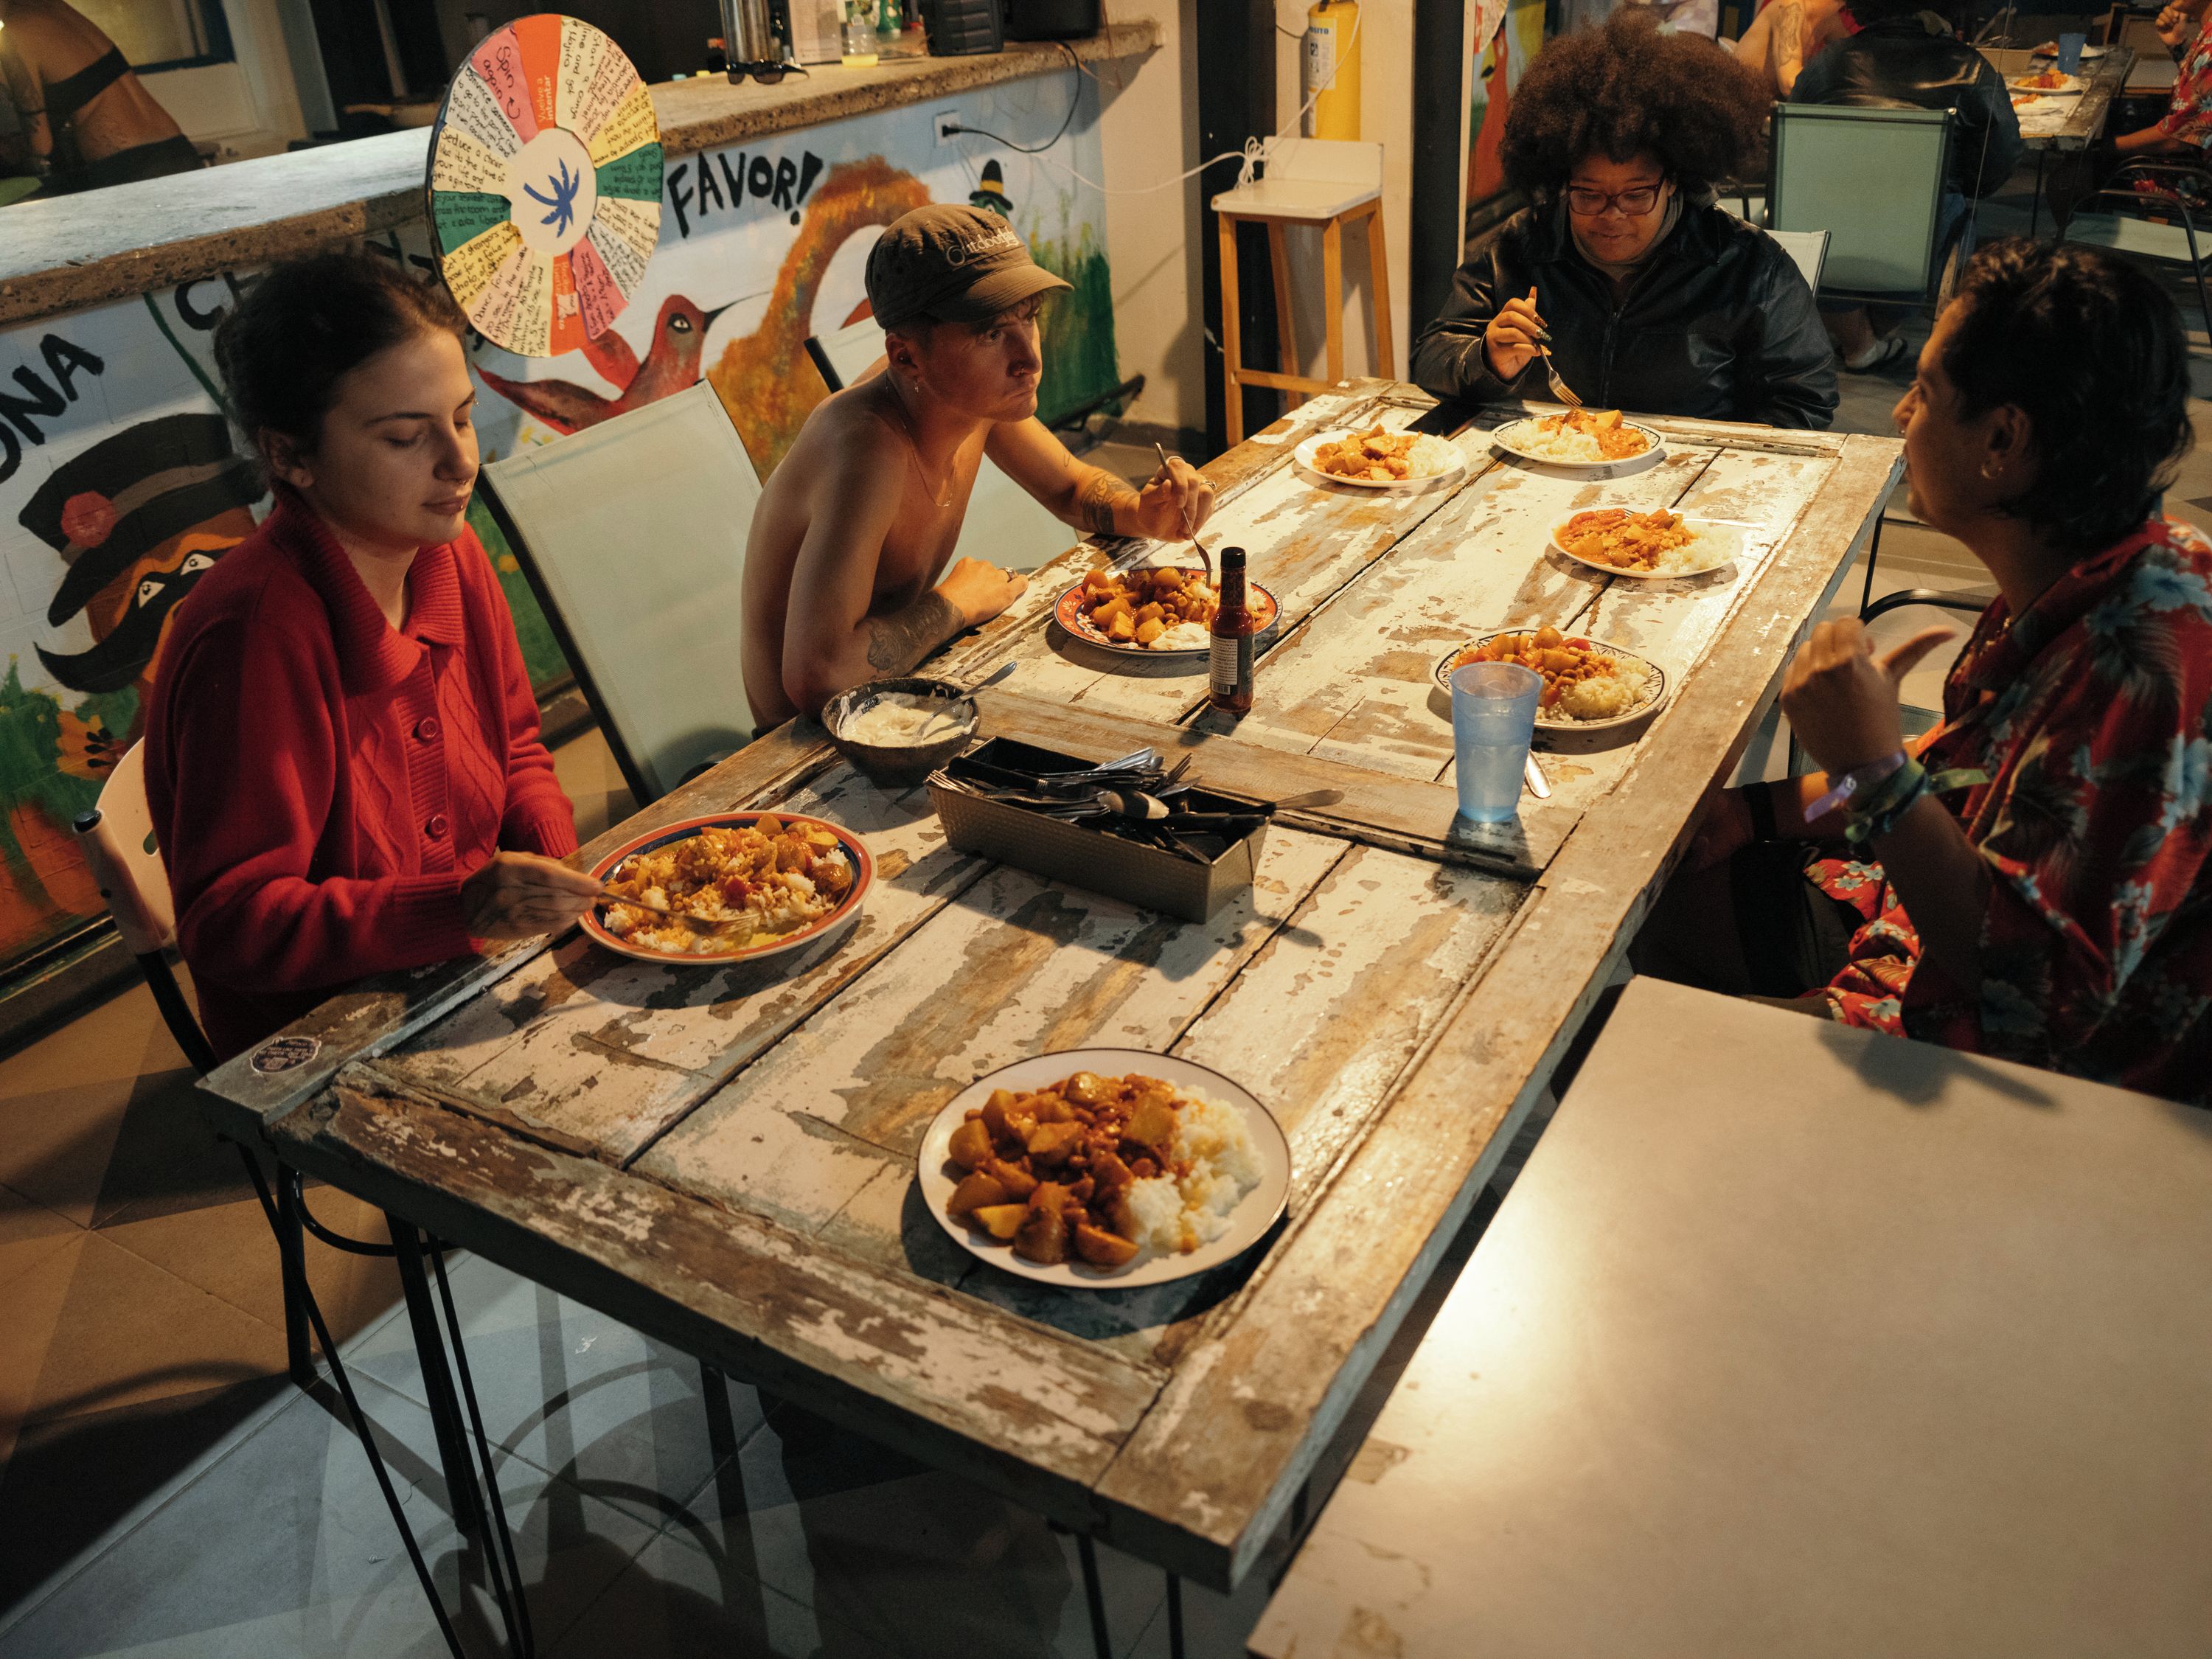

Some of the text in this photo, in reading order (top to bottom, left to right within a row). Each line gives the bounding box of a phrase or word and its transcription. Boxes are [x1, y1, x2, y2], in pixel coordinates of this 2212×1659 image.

[496, 46, 514, 88] Spin
[566, 28, 591, 94] line and get
[589, 32, 601, 67] Start
[484, 60, 502, 100] again
[544, 75, 553, 120] intentar
[570, 90, 584, 119] conga
[441, 128, 472, 153] Seduce
[476, 149, 481, 157] a
[667, 150, 823, 239] FAVOR!
[473, 292, 493, 324] Dance
[490, 271, 504, 289] for
